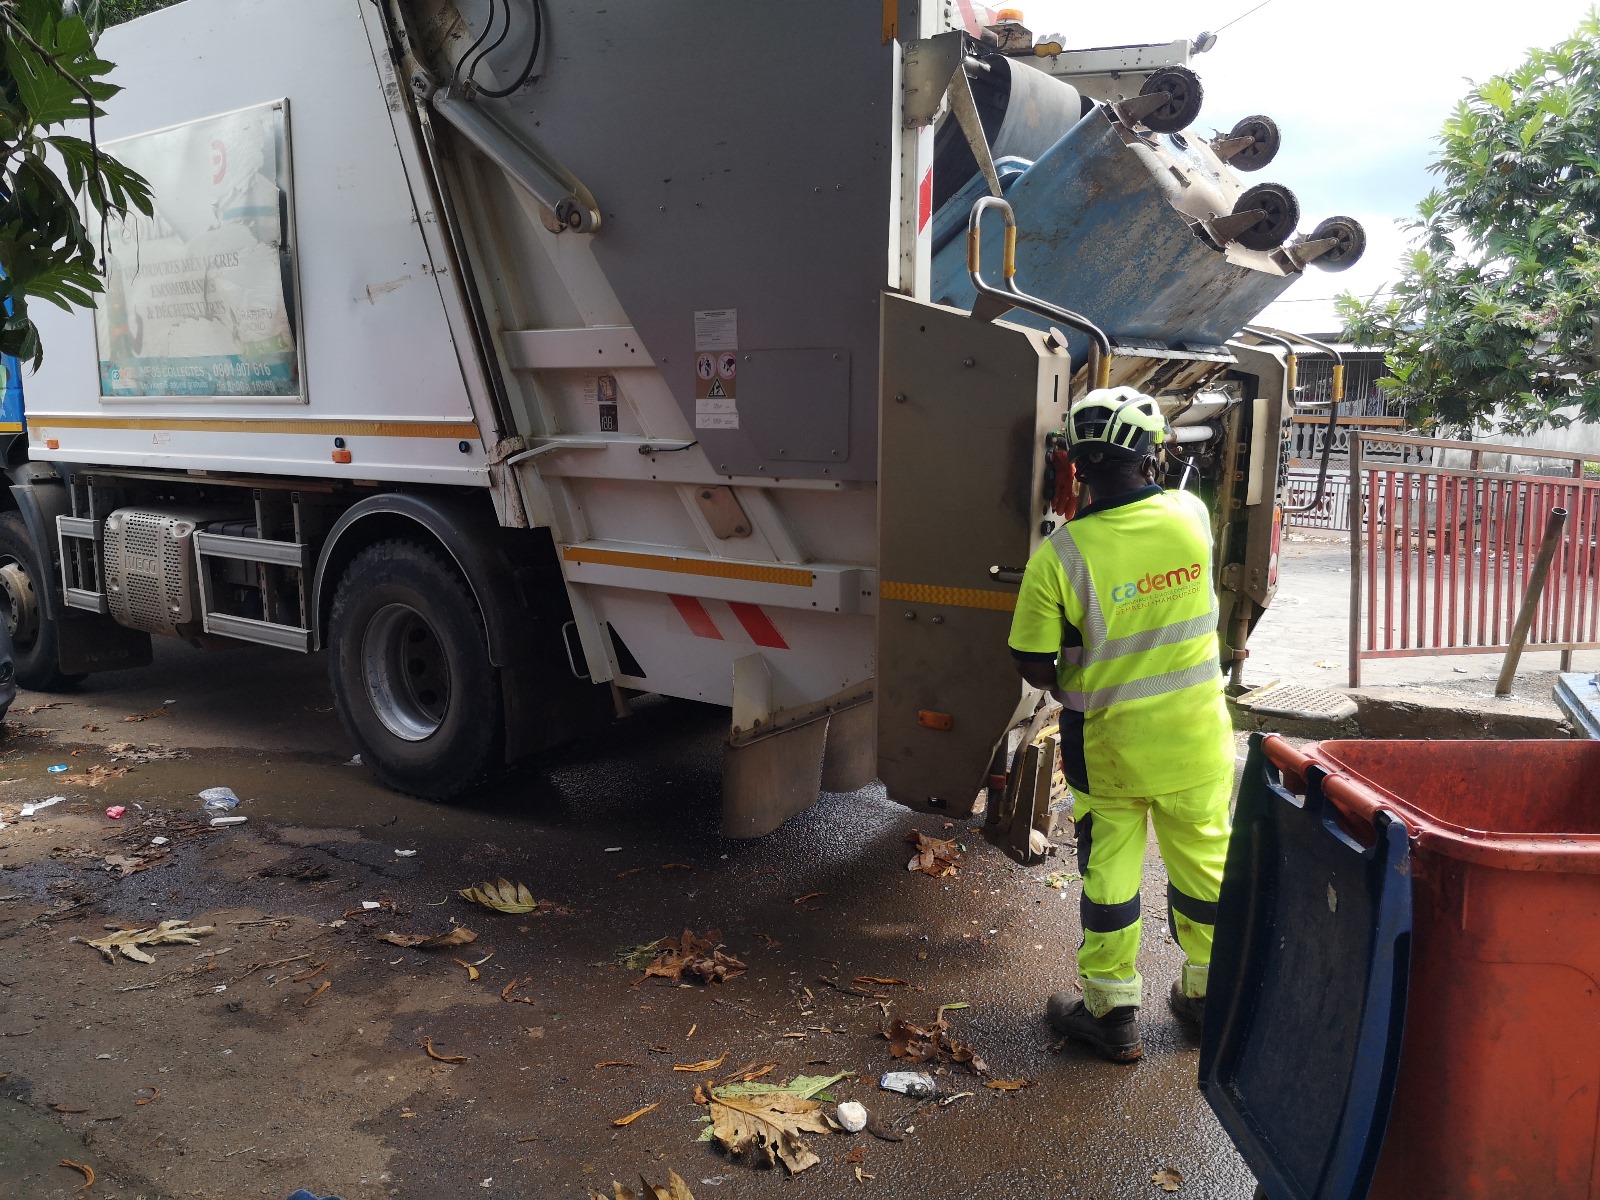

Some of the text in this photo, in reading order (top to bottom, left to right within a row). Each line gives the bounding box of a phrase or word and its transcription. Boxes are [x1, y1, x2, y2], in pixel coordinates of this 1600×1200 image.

[162, 365, 205, 377] COLLECTES
[213, 362, 234, 377] 0801
[236, 362, 250, 377] 907
[253, 362, 271, 377] 616
[124, 555, 157, 575] IVECO
[1111, 563, 1201, 603] cadema
